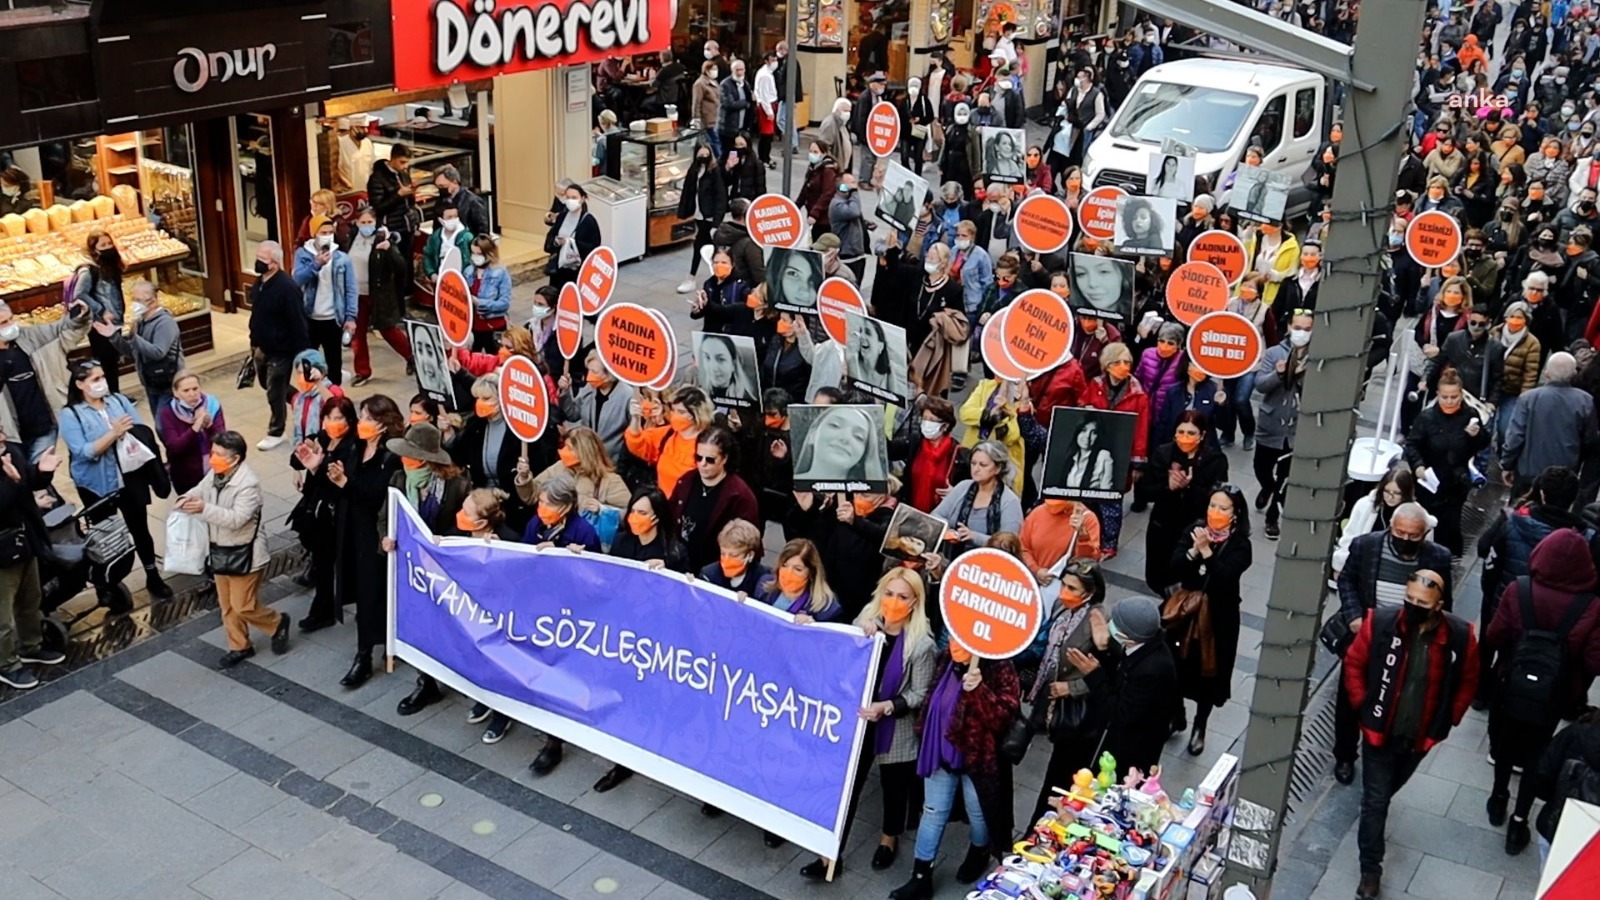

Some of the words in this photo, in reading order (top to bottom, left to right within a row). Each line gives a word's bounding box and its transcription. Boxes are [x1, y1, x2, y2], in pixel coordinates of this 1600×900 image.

[435, 0, 649, 73] Dönerevi
[173, 43, 276, 92] Onur
[754, 204, 788, 219] KADINA
[757, 217, 792, 233] ŞİDDETE
[1418, 221, 1453, 236] SESİMİZİ
[764, 231, 791, 243] HAYIR
[1420, 235, 1434, 245] SEN
[1436, 238, 1447, 248] DE
[1208, 254, 1226, 266] İÇİN
[1422, 248, 1440, 258] DUY
[1181, 268, 1221, 288] ŞİDDETE
[1188, 286, 1208, 300] GÖZ
[1019, 300, 1068, 333] KADINLAR
[611, 316, 656, 341] KADINA
[1025, 322, 1047, 342] İÇİN
[1201, 330, 1247, 346] ŞİDDETE
[608, 332, 656, 360] ŞİDDETE
[1010, 335, 1048, 362] ADALET
[1200, 345, 1224, 358] DUR
[1226, 348, 1245, 360] DE!
[612, 352, 648, 375] HAYIR
[508, 384, 536, 408] ŞİDDET
[957, 563, 1033, 606] GÜCÜNÜN
[951, 585, 1027, 630] FARKINDA
[972, 620, 992, 641] OL
[531, 608, 716, 694] SÖZLEŞMESİ
[723, 664, 842, 743] YAŞATIR
[1373, 636, 1401, 718] POLİS
